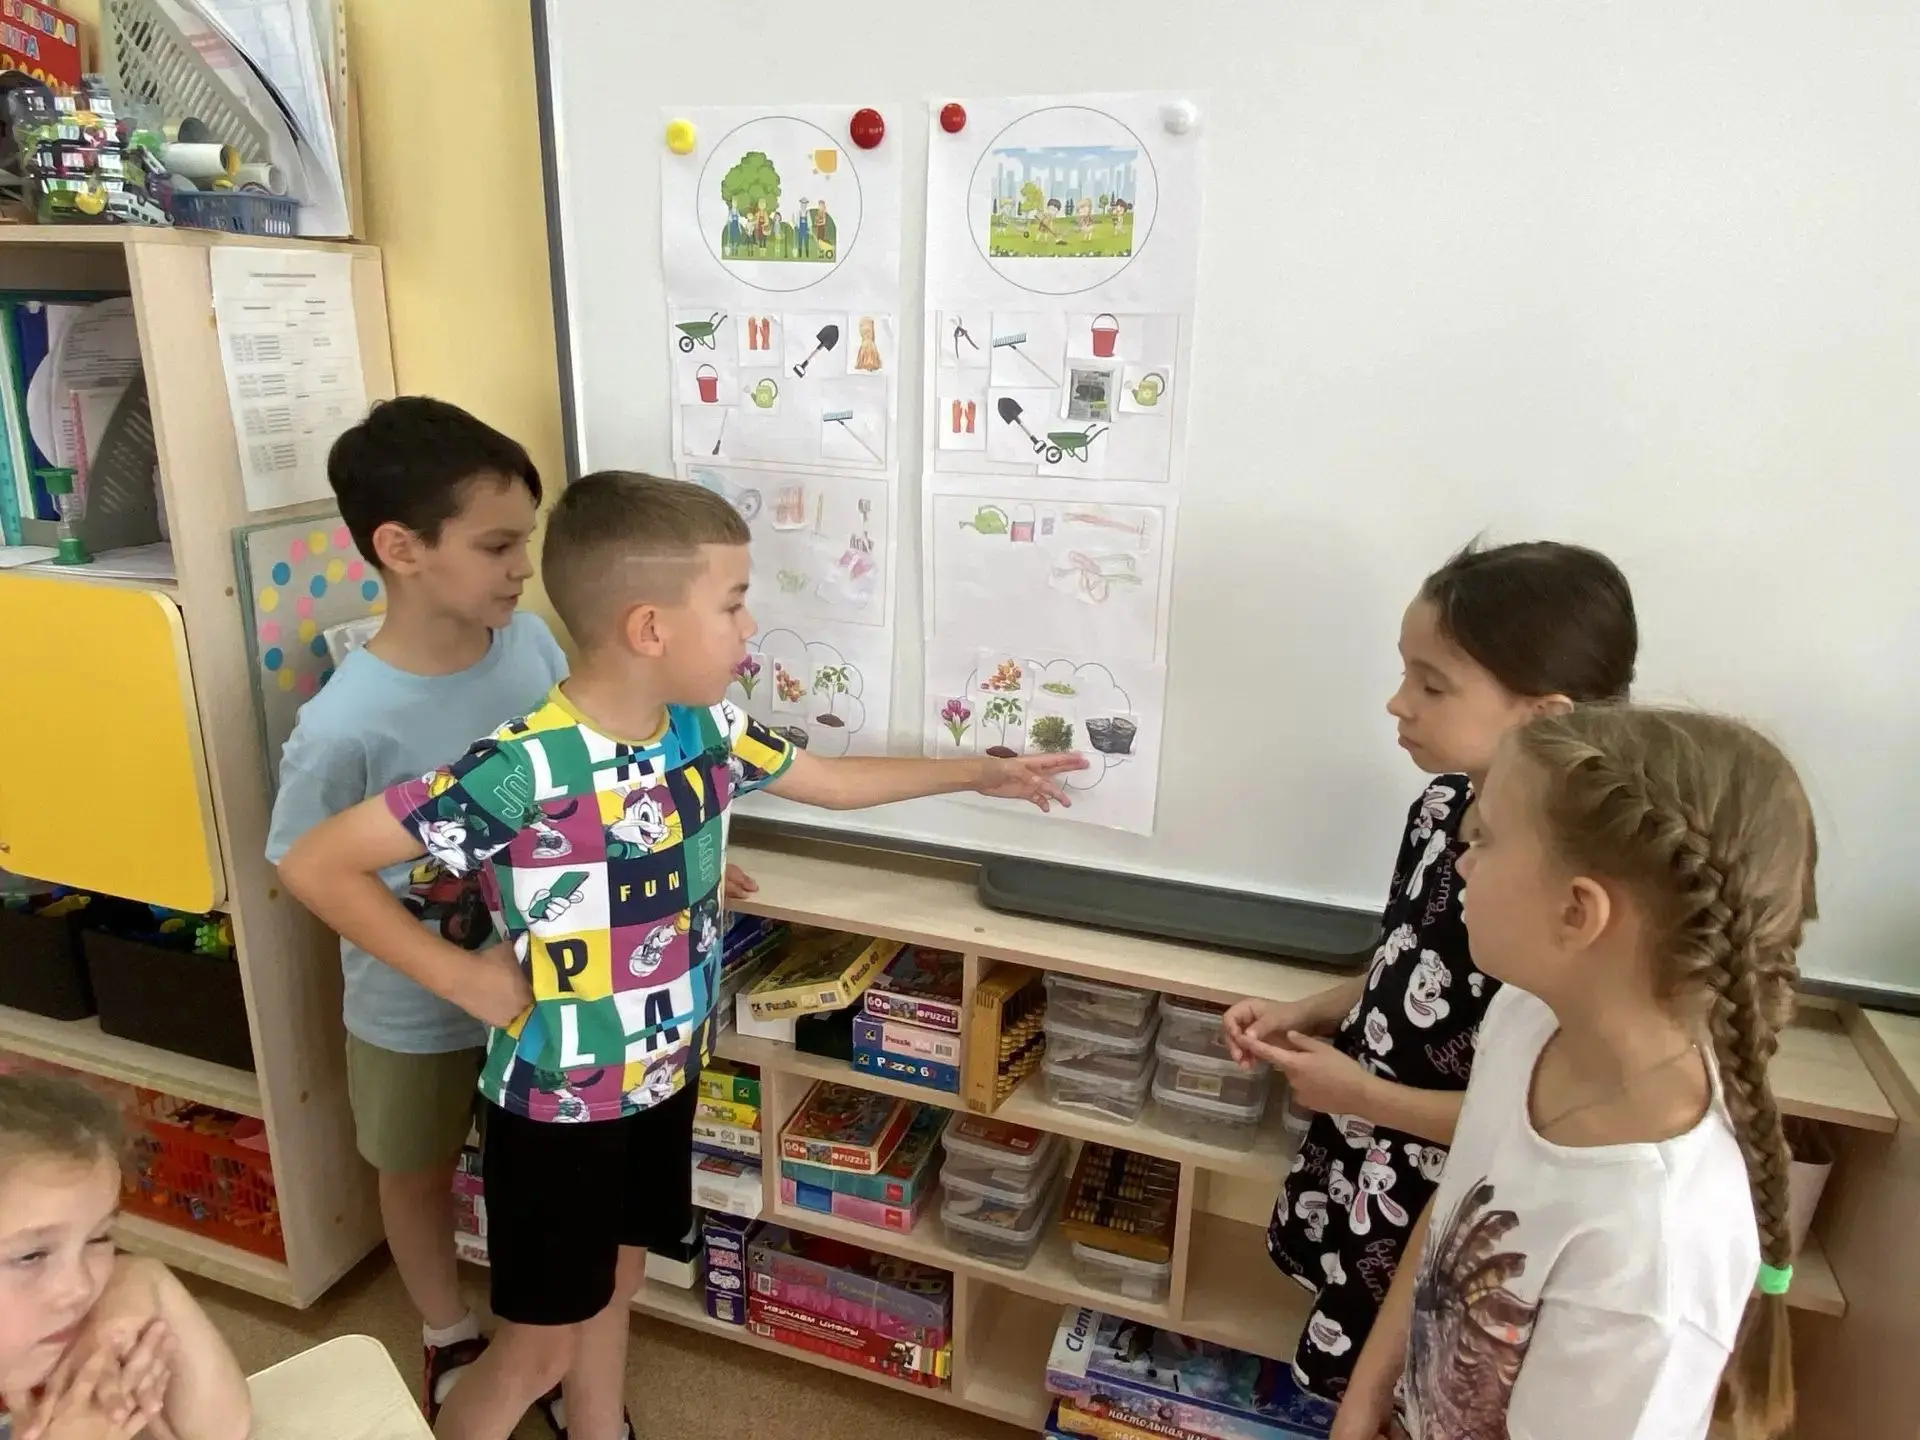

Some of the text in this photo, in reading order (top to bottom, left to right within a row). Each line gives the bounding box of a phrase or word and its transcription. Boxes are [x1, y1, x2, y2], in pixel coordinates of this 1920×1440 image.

[620, 871, 680, 902] FUN
[924, 1010, 957, 1024] PUZZLE
[840, 1153, 870, 1165] PUZZLE
[763, 1304, 816, 1323] ИЗУЧАЕМ
[819, 1319, 859, 1336] ЦИФРЫ
[1108, 1408, 1184, 1440] настольная
